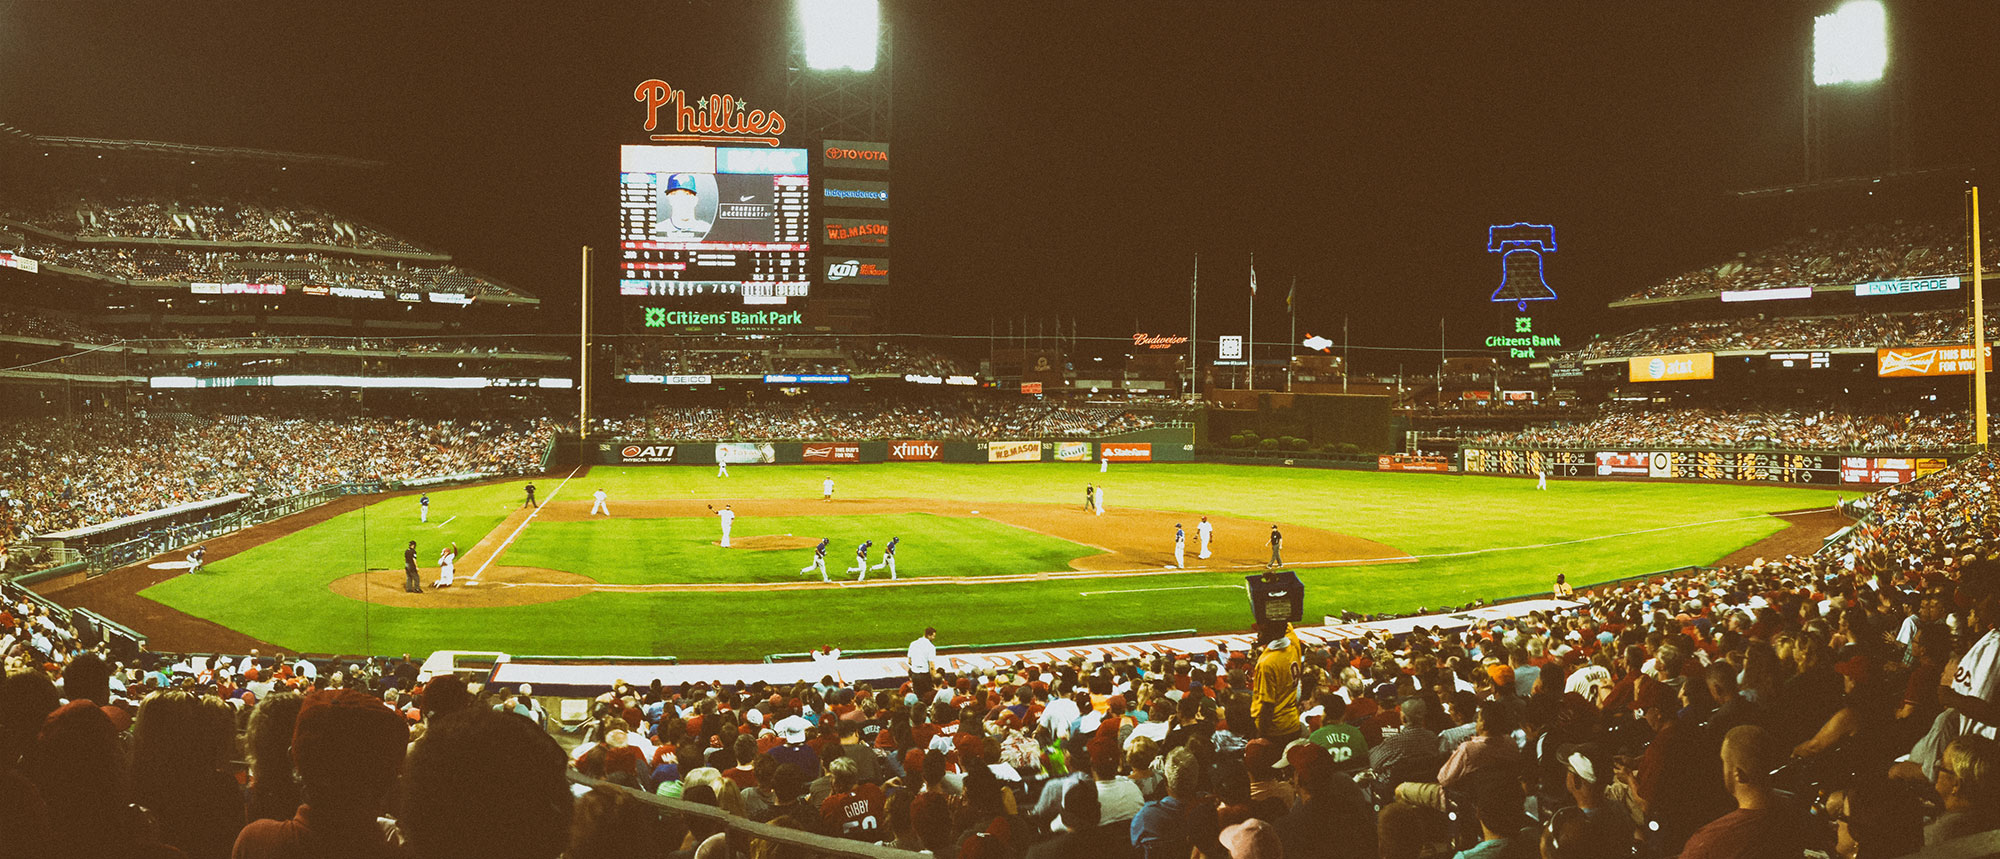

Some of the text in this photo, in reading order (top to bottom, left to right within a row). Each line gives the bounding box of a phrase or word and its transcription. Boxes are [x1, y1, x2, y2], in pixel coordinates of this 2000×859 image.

[633, 79, 786, 135] Phillies
[841, 149, 888, 161] TOYOTA
[1869, 279, 1948, 295] POWERADE
[666, 310, 803, 325] Citizens Bank Park
[1133, 332, 1188, 346] Budweiser
[1485, 334, 1561, 347] Citizens Bank
[1510, 347, 1536, 359] Park
[1939, 349, 1959, 361] THIS
[1939, 361, 1957, 372] FOR
[639, 446, 675, 457] ATI
[892, 442, 938, 459] xfinity
[1326, 733, 1351, 745] UTLEY
[844, 799, 869, 818] GIBBY
